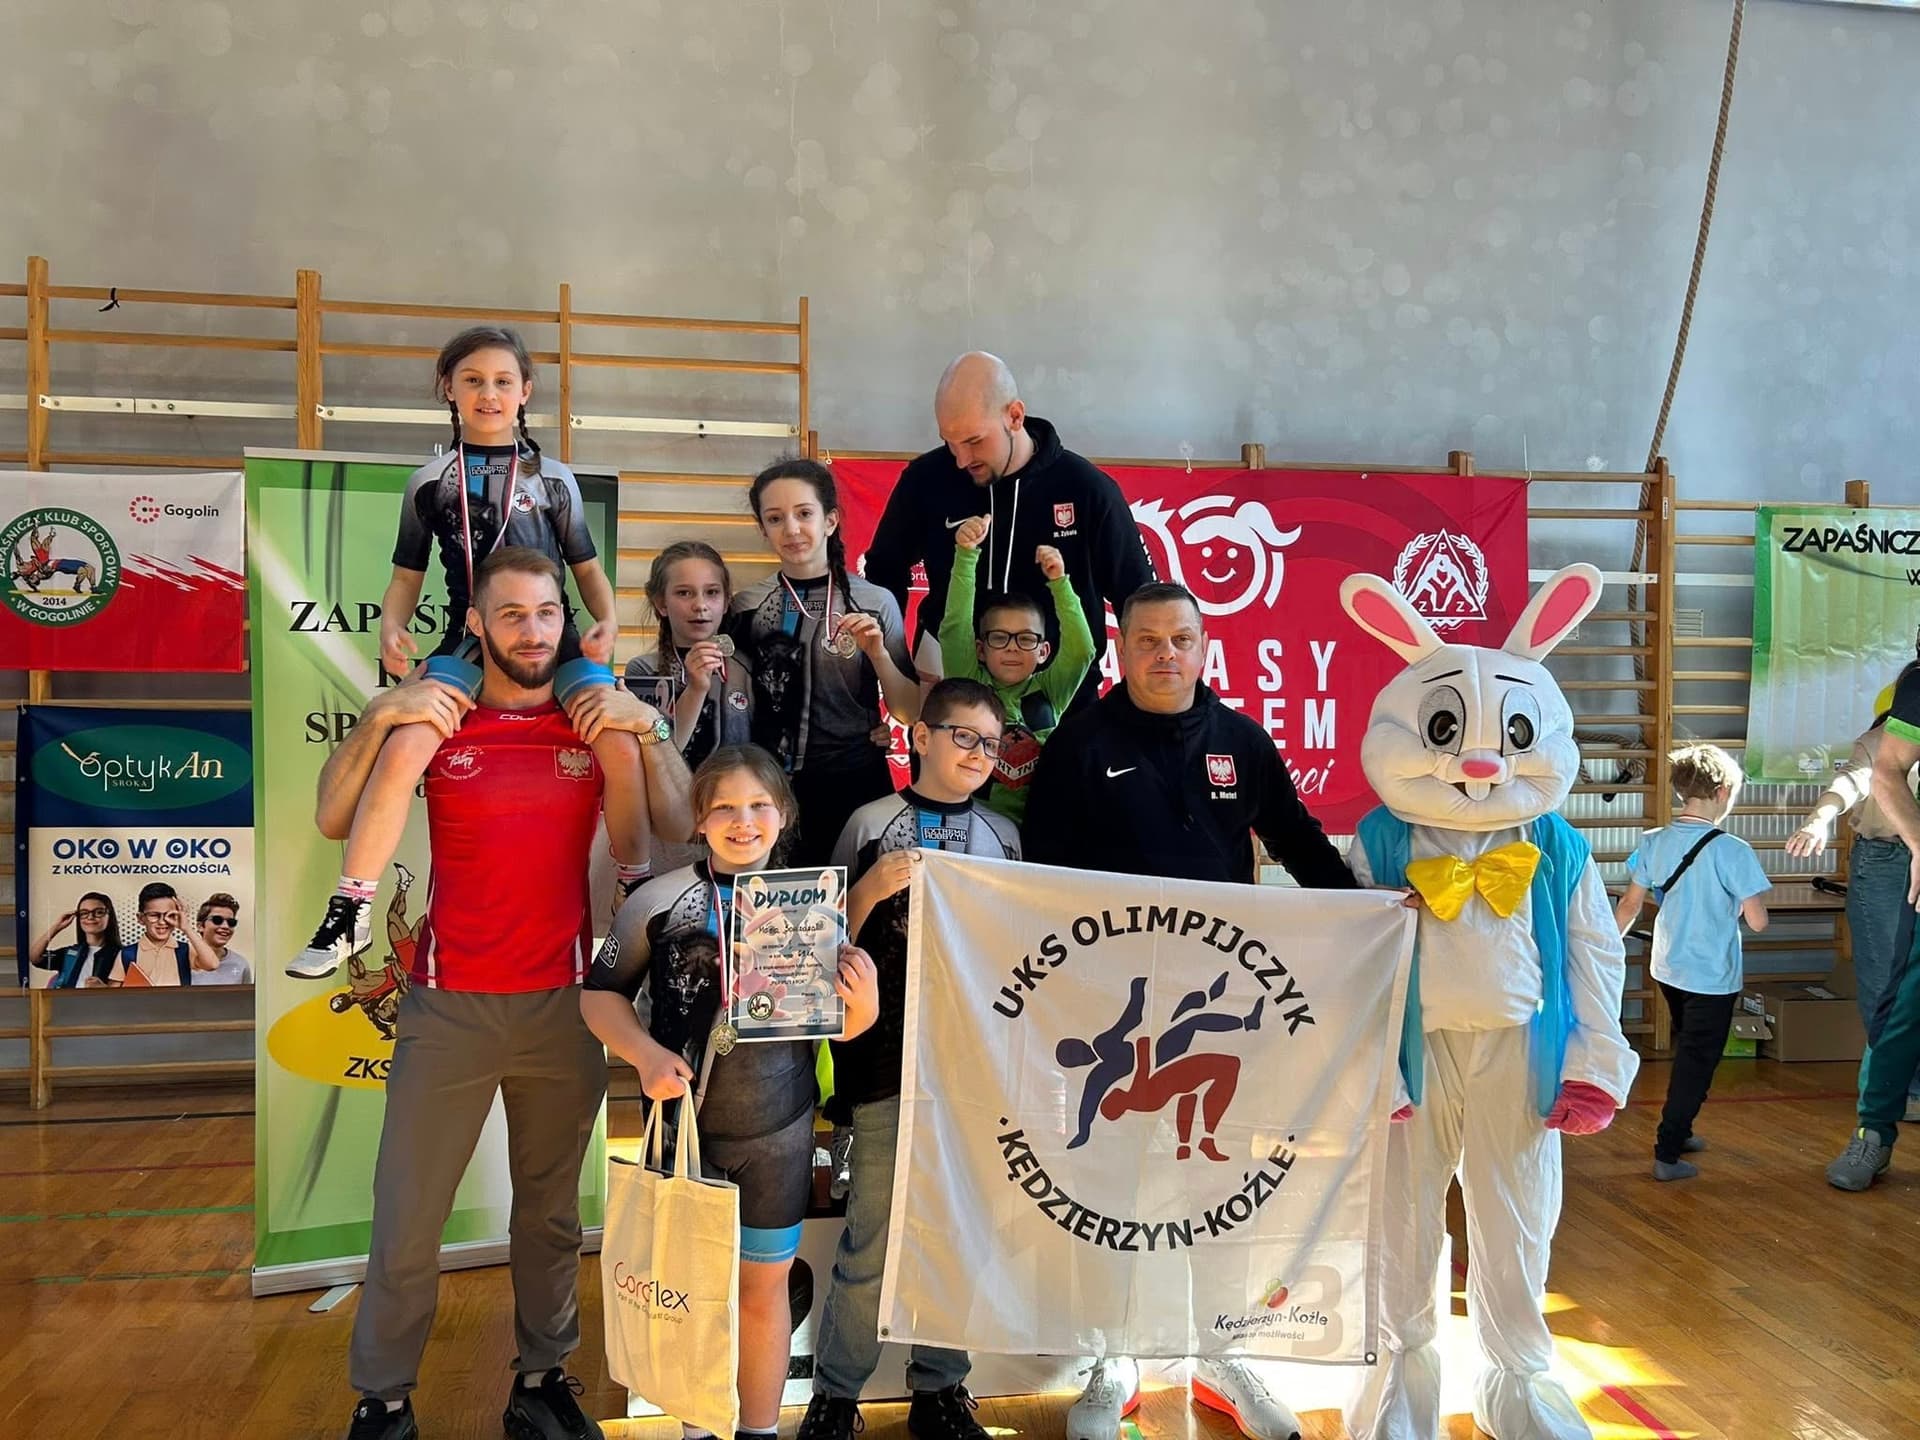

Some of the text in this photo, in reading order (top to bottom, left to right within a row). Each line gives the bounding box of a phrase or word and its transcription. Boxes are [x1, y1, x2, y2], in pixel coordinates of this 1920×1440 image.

[164, 504, 219, 519] Gogolin
[44, 512, 80, 525] KLUB
[81, 521, 117, 587] SPORTOWY
[15, 599, 96, 622] W GOGOLINIE
[42, 597, 66, 606] 2014
[1097, 639, 1337, 691] AASY
[53, 838, 231, 859] OKO W OKO
[52, 861, 231, 876] Z KRÓTKOWZROCZNOŚCIĄ
[754, 888, 827, 909] DYPLOM
[1071, 905, 1315, 1036] OLIMPIJCZYK
[343, 1056, 393, 1080] ZKS
[996, 1129, 1297, 1252] KĘDZIERZYN-KOŹLE
[1214, 1305, 1328, 1332] Kędzierzyn-Koźle
